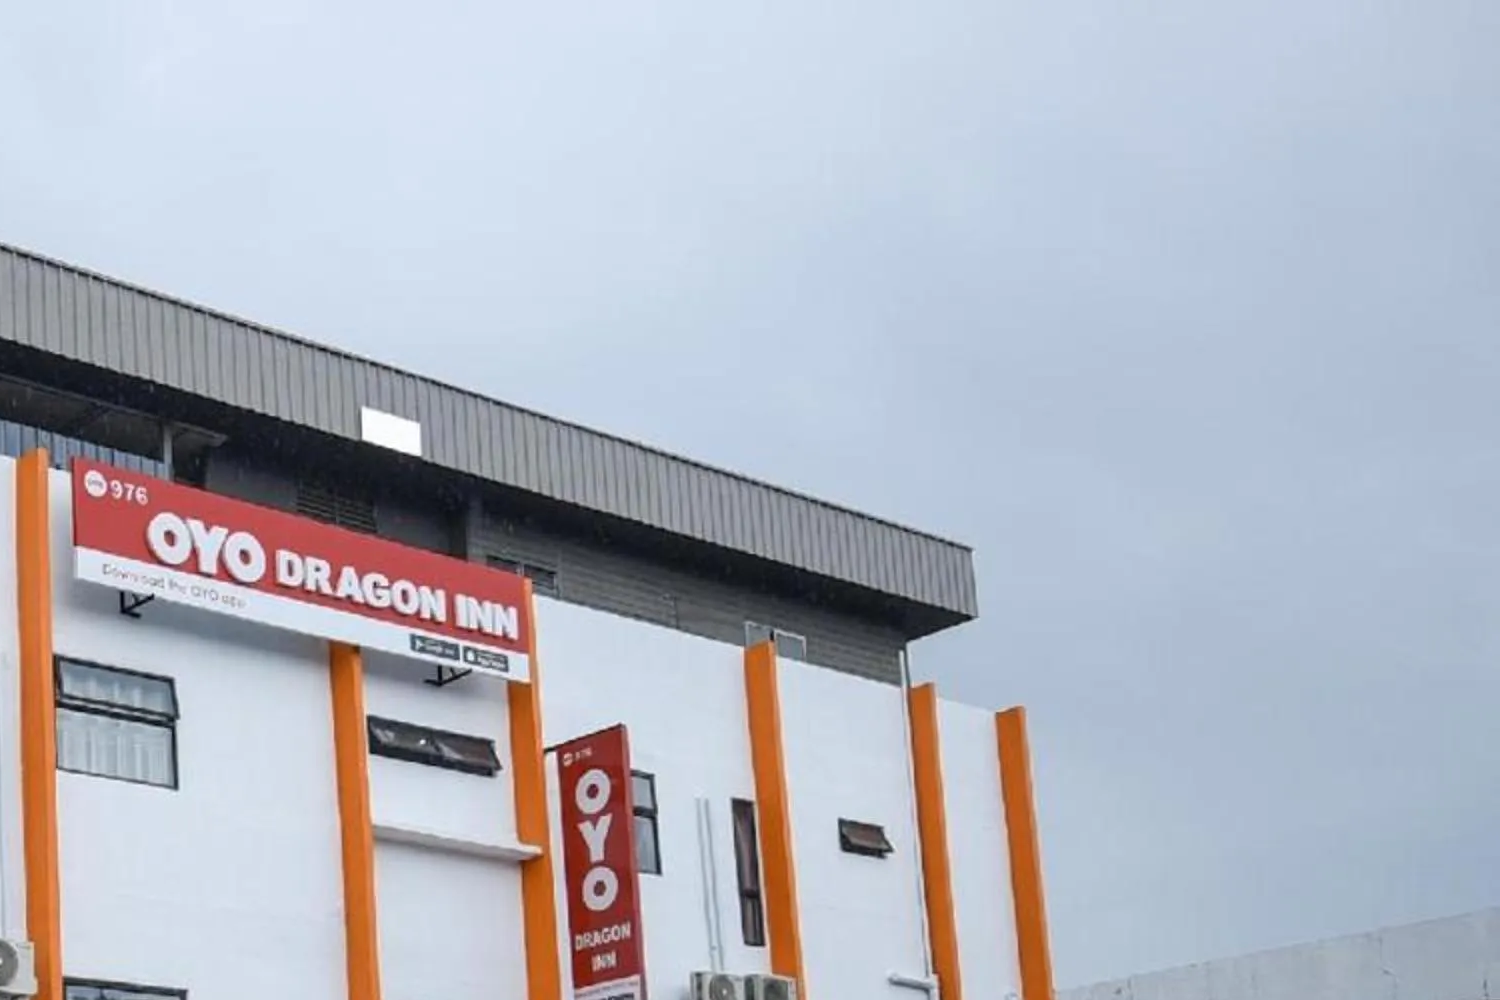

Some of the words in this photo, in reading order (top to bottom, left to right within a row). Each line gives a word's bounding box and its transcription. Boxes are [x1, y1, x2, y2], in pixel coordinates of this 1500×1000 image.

[110, 479, 149, 506] 976
[146, 511, 267, 584] OYO
[275, 549, 447, 622] DRAGON
[454, 592, 519, 640] INN
[574, 768, 619, 911] OYO
[574, 921, 631, 951] DRAGON
[591, 952, 616, 972] INN
